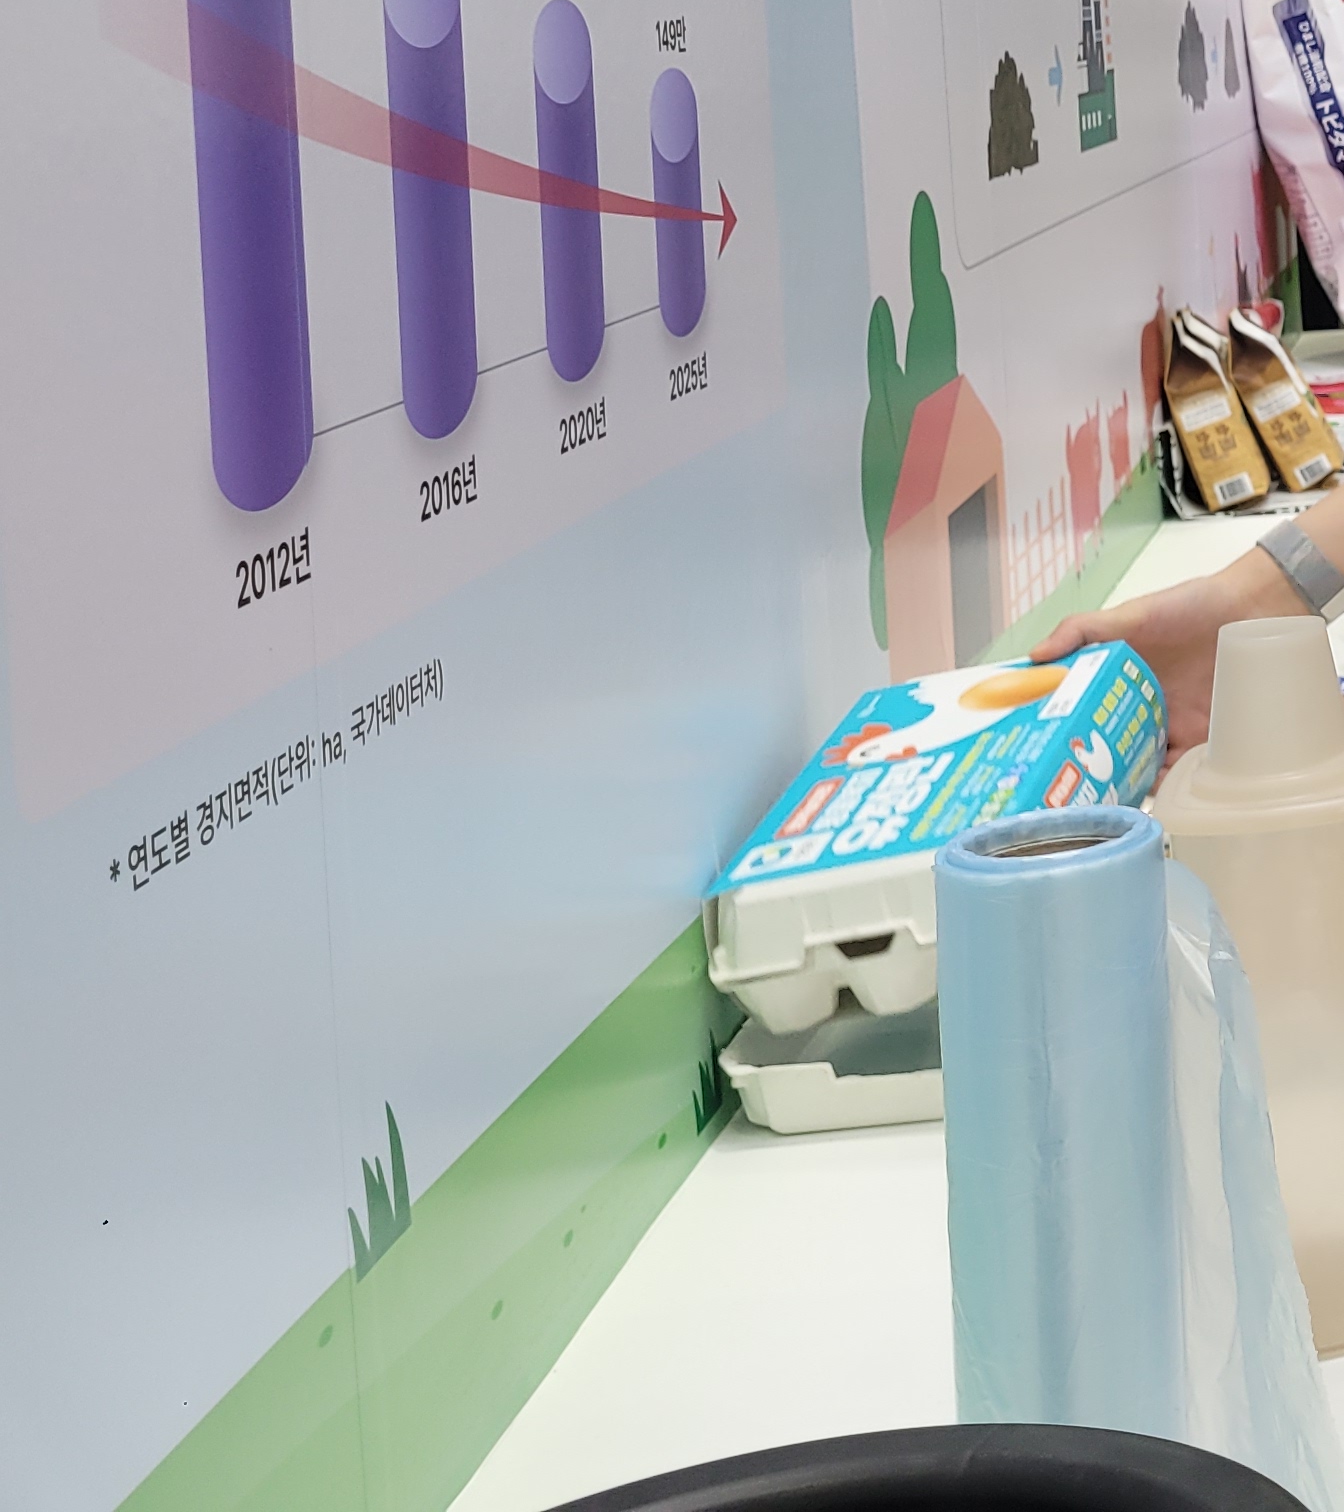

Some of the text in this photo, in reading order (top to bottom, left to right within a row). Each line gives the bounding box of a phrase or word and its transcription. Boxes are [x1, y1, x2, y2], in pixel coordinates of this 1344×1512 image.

[655, 15, 687, 53] 149만
[668, 350, 709, 401] 2025년
[558, 396, 608, 455] 2020년
[419, 454, 478, 523] 2016년
[235, 526, 313, 609] 2012년
[127, 657, 444, 892] 연도별 경지면적(단위: ha, 국가데이터처)
